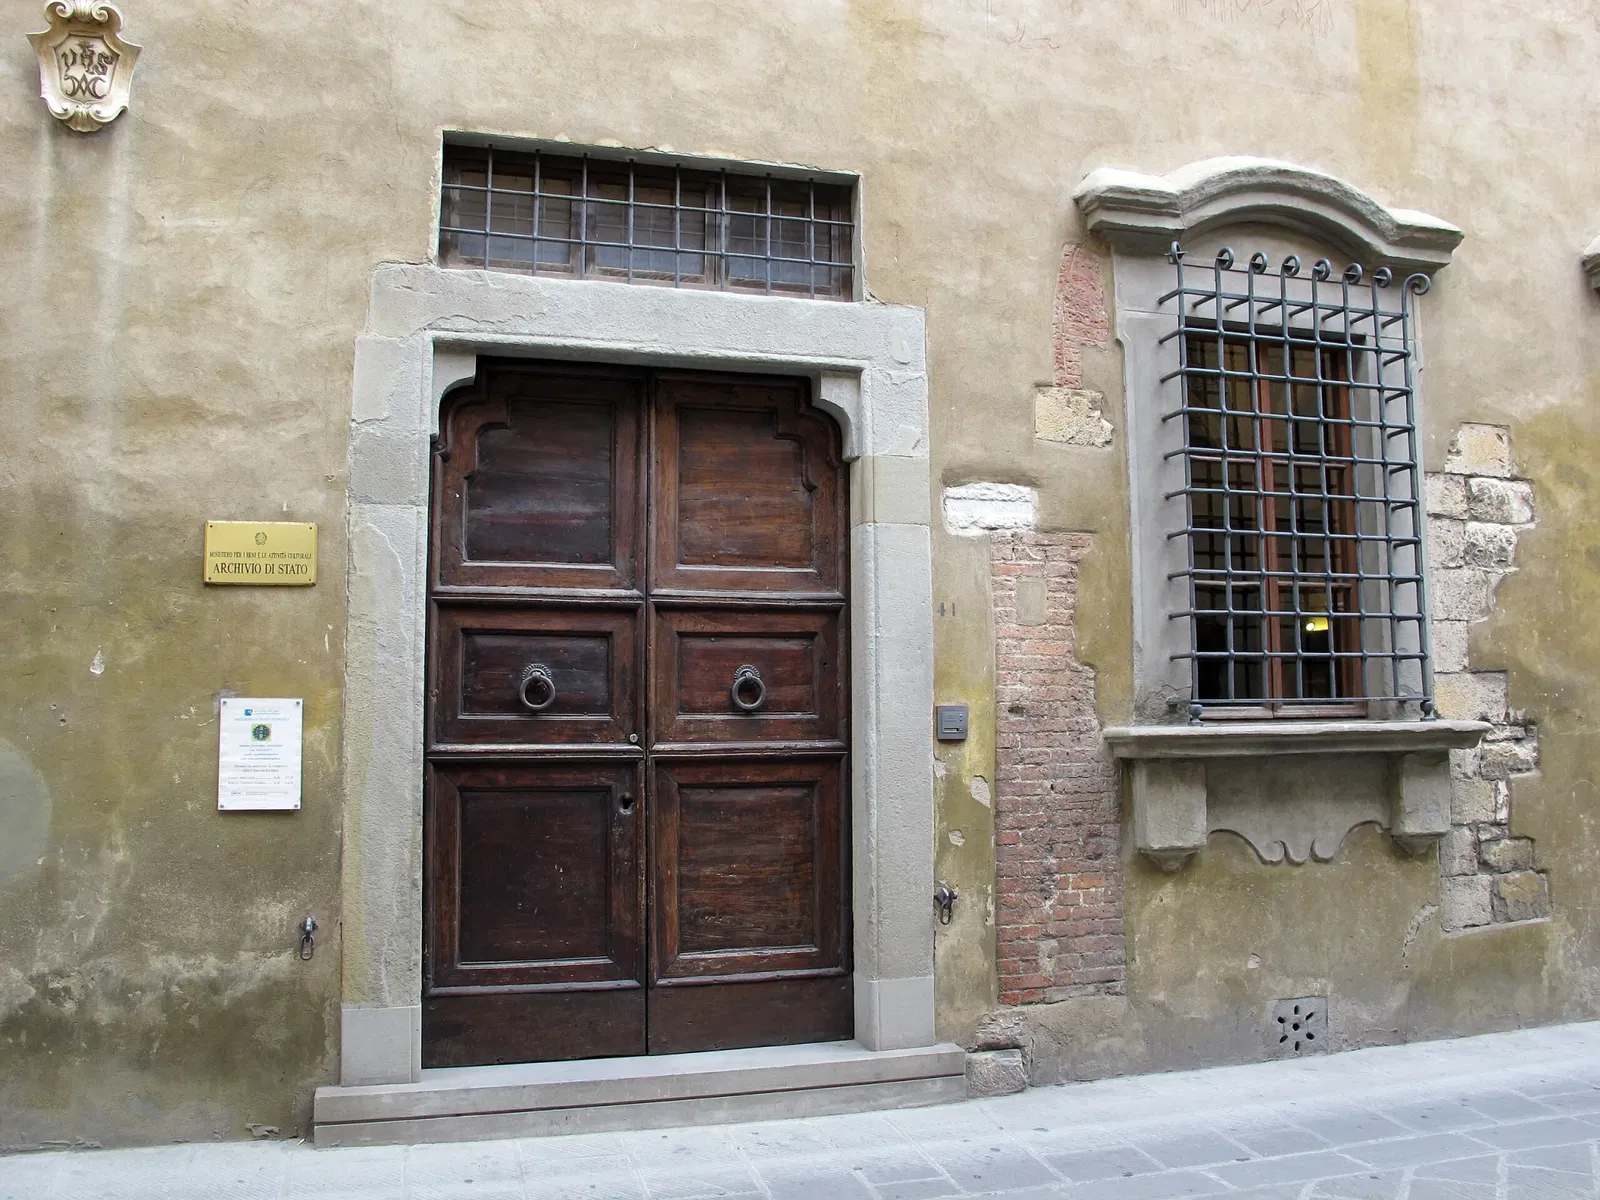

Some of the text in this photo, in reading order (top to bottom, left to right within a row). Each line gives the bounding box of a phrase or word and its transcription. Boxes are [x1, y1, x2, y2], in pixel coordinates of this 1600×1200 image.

[213, 562, 308, 575] ARCHIVIO DI STATO
